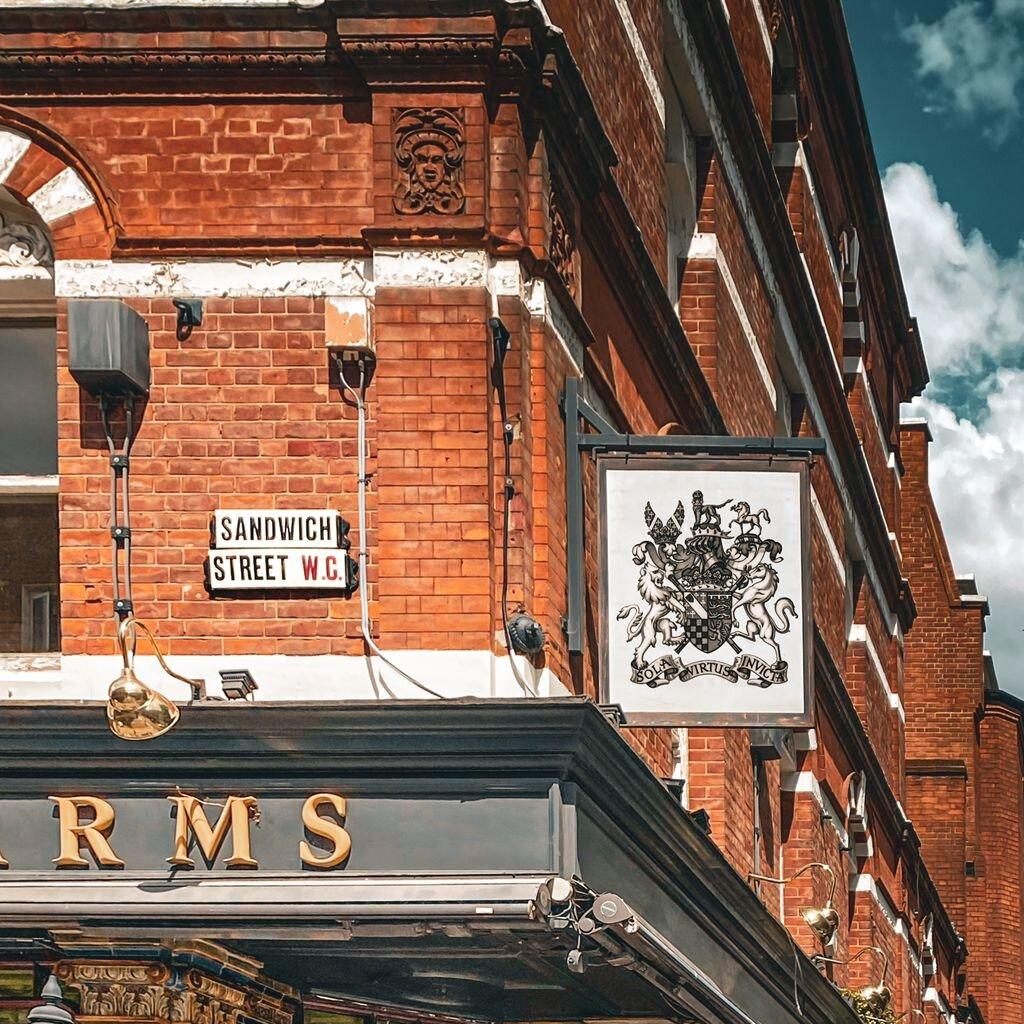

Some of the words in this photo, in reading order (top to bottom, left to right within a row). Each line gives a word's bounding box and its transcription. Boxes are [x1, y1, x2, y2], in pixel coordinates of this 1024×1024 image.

[221, 516, 332, 541] SANDWICH
[213, 555, 289, 581] STREET
[301, 555, 343, 581] W.C.
[636, 658, 673, 683] SOLA
[686, 661, 732, 677] VIRTUS
[742, 656, 786, 682] INVICTA
